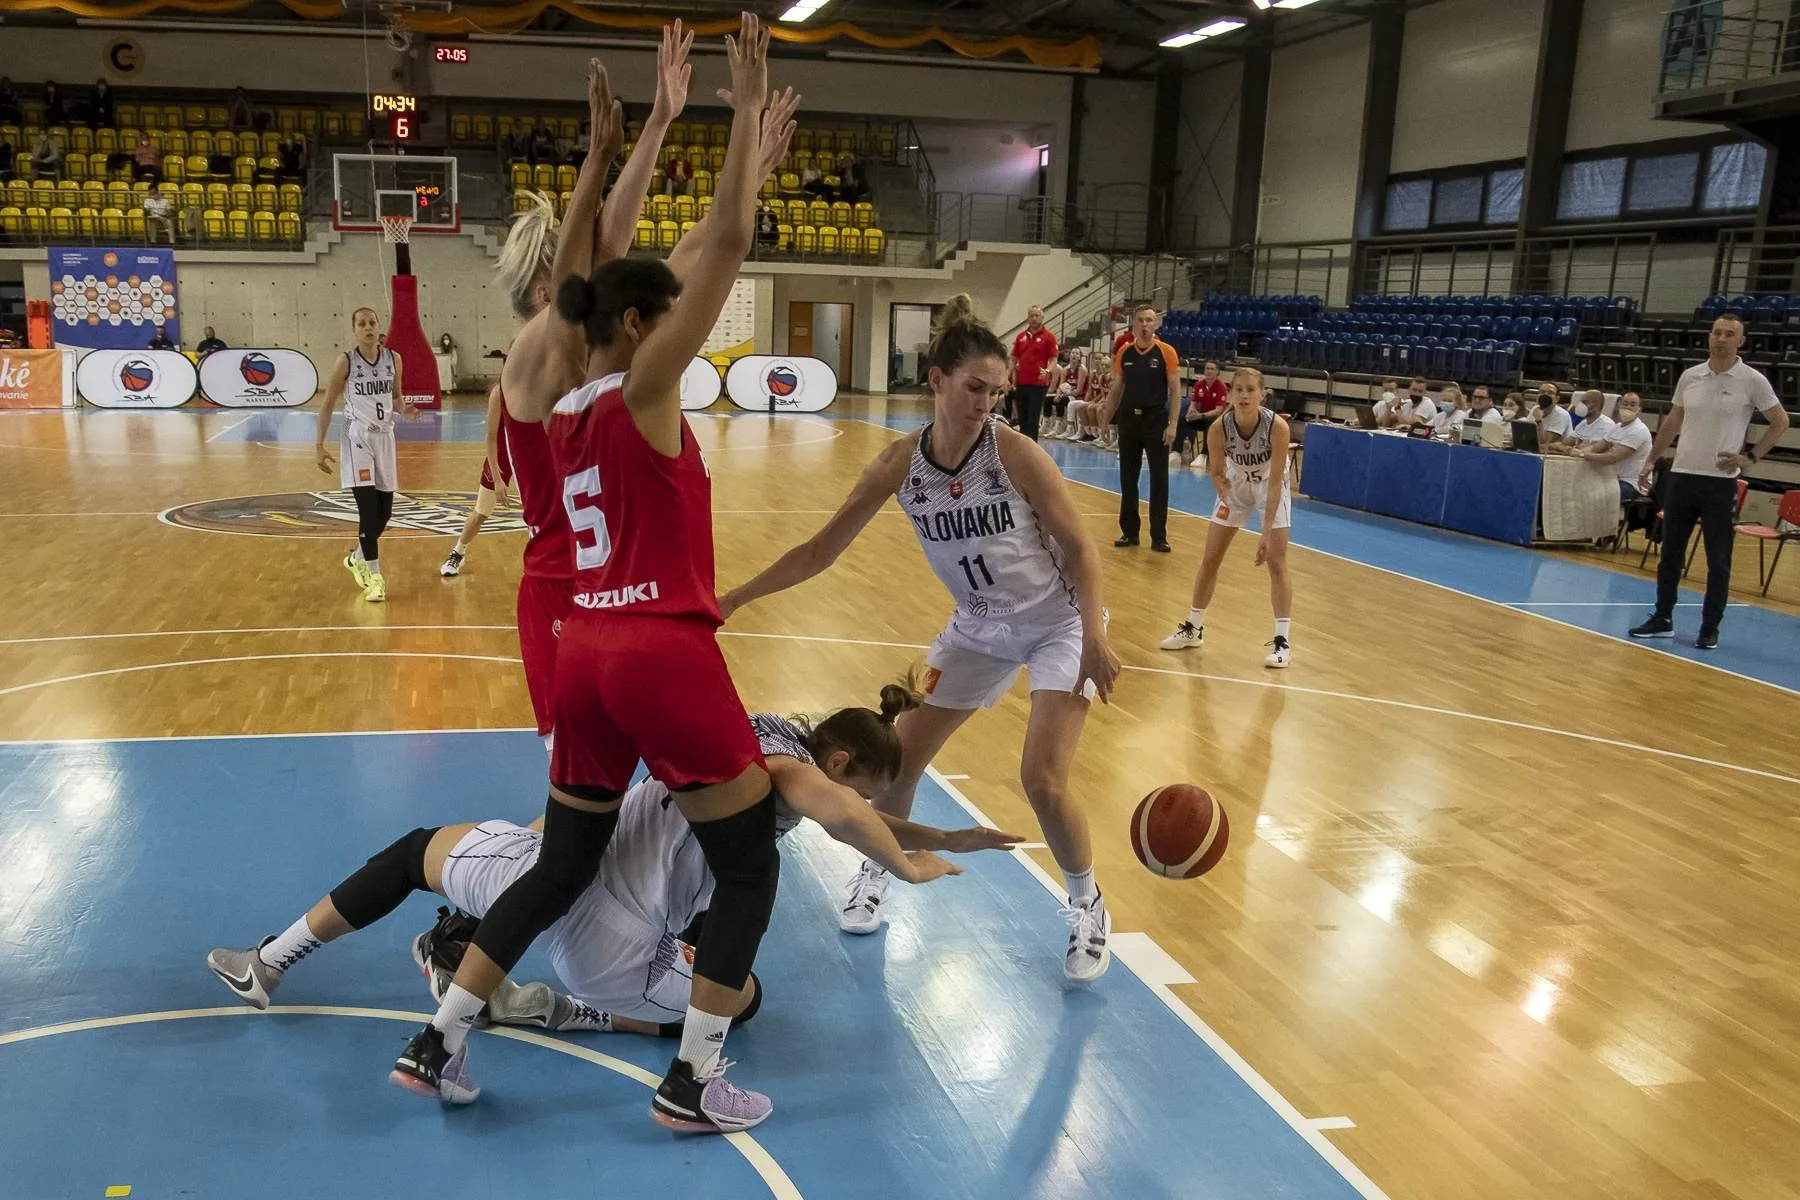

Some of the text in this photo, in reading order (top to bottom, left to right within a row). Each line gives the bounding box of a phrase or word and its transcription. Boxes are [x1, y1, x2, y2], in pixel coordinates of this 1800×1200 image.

[397, 118, 409, 138] 6
[234, 386, 288, 403] SBA
[375, 402, 385, 421] 6
[1244, 470, 1262, 483] 15
[562, 464, 612, 571] 5
[912, 500, 1016, 542] SLOVAKIA
[958, 554, 995, 591] 11
[573, 580, 660, 609] SUZUKI
